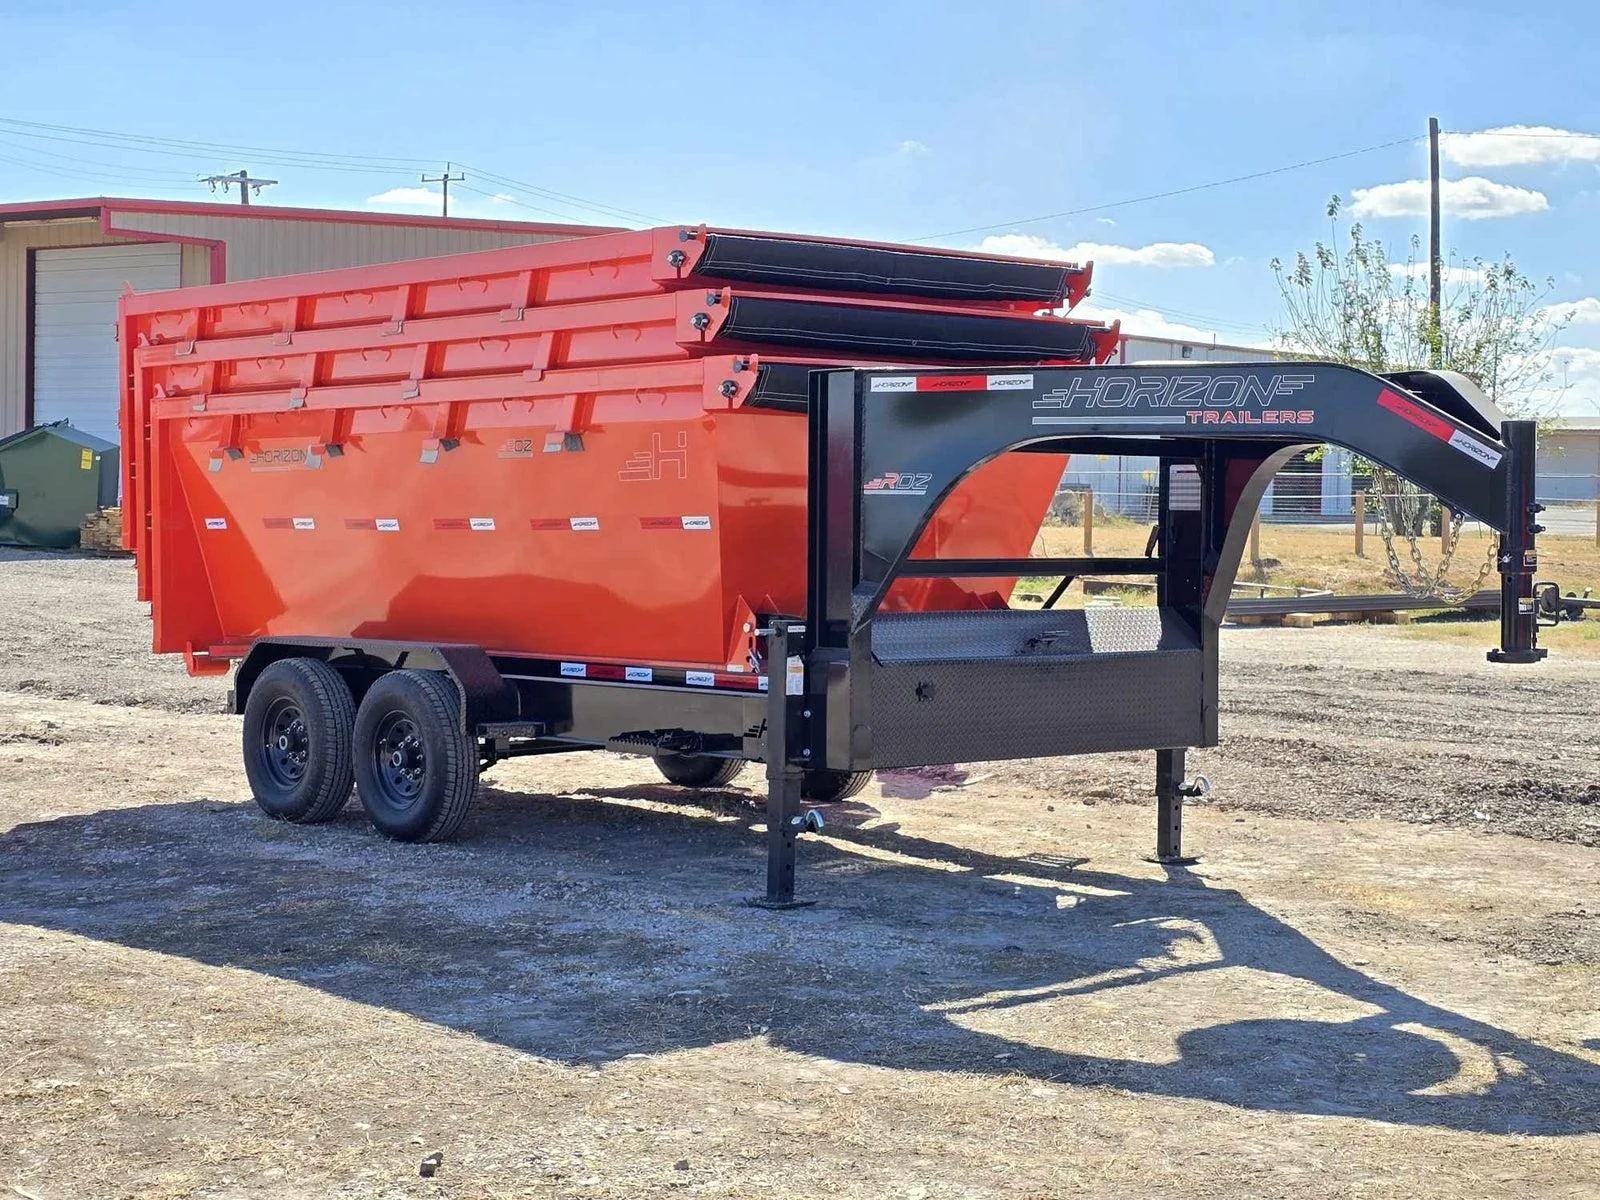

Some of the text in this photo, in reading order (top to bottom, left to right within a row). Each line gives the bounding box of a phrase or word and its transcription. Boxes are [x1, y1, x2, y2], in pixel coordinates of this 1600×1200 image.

[1062, 375, 1283, 408] HORIZON
[1186, 410, 1315, 425] TRAILERS
[256, 448, 308, 464] HORIZON
[1456, 438, 1495, 461] HORIZON
